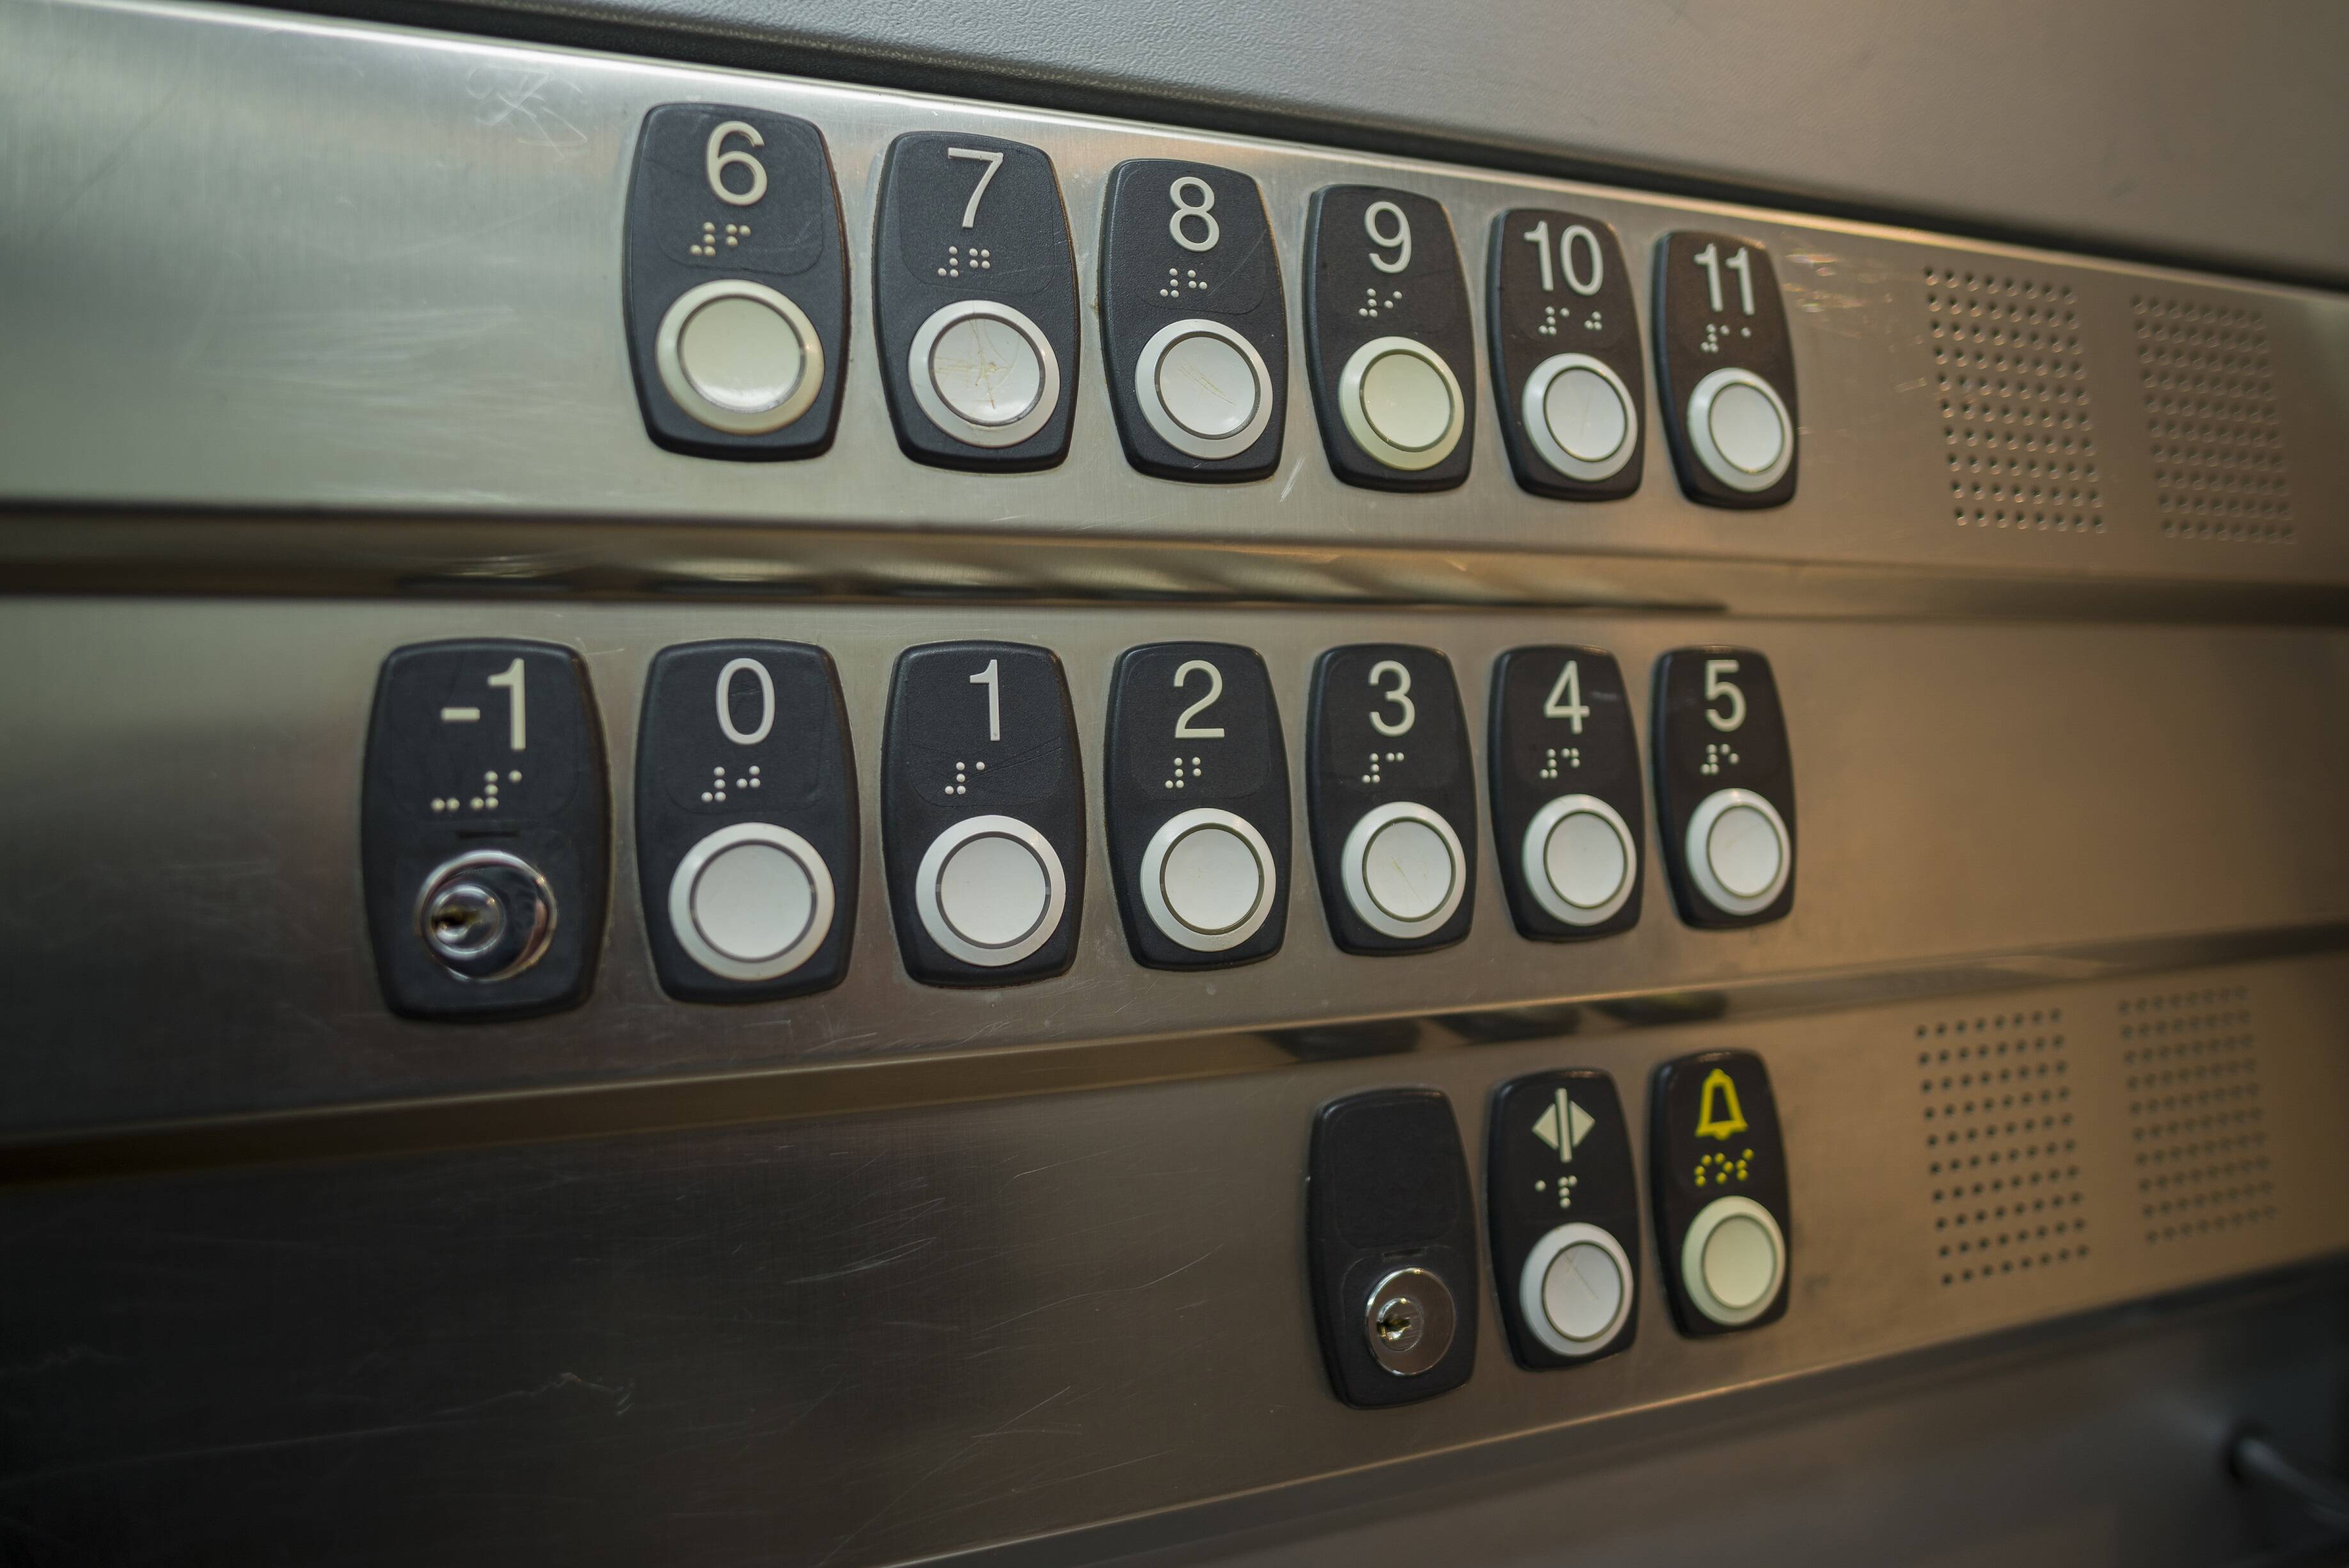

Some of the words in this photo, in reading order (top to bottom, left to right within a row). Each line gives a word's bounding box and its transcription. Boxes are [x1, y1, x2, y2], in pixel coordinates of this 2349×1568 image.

[707, 121, 767, 204] 6
[947, 147, 1003, 227] 7
[1169, 177, 1219, 251] 8
[1365, 202, 1411, 273] 9
[1524, 220, 1604, 295] 10
[1694, 243, 1755, 315] 11
[441, 658, 525, 750] -1
[716, 658, 775, 745] 0
[969, 660, 1000, 741] 1
[1173, 660, 1224, 738] 2
[1369, 661, 1414, 735] 3
[1545, 661, 1590, 733] 4
[1706, 660, 1745, 731] 5
